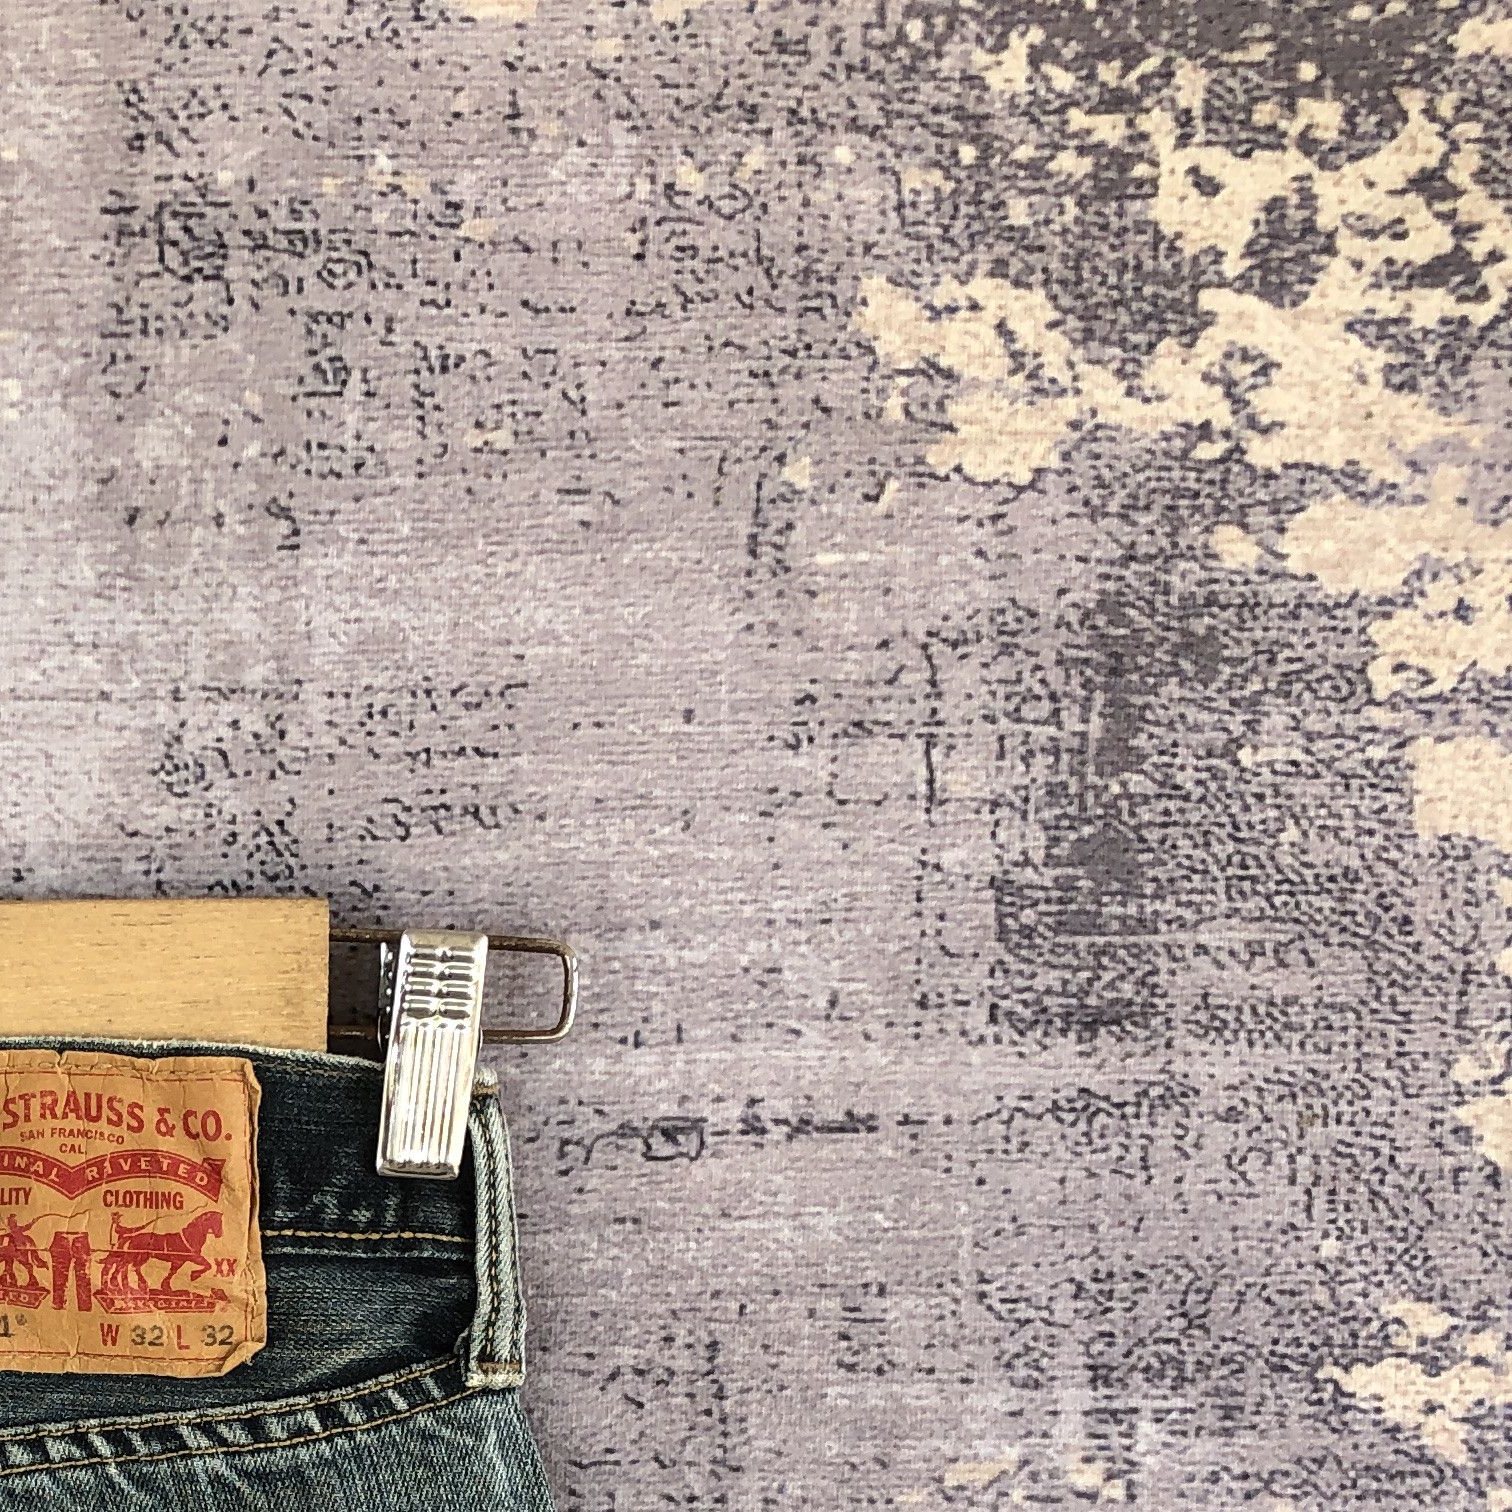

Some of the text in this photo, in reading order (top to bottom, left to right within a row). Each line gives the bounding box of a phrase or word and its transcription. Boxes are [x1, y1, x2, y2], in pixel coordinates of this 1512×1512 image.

[3, 1090, 145, 1133] STRAUSS
[155, 1107, 176, 1138] &
[183, 1109, 232, 1141] CO.
[20, 1127, 125, 1145] SAN FRANCISCO
[85, 1157, 208, 1186] RIVETED
[104, 1189, 184, 1210] CLOTHING
[213, 1258, 237, 1277] XX
[100, 1322, 234, 1350] W 32 L 32
